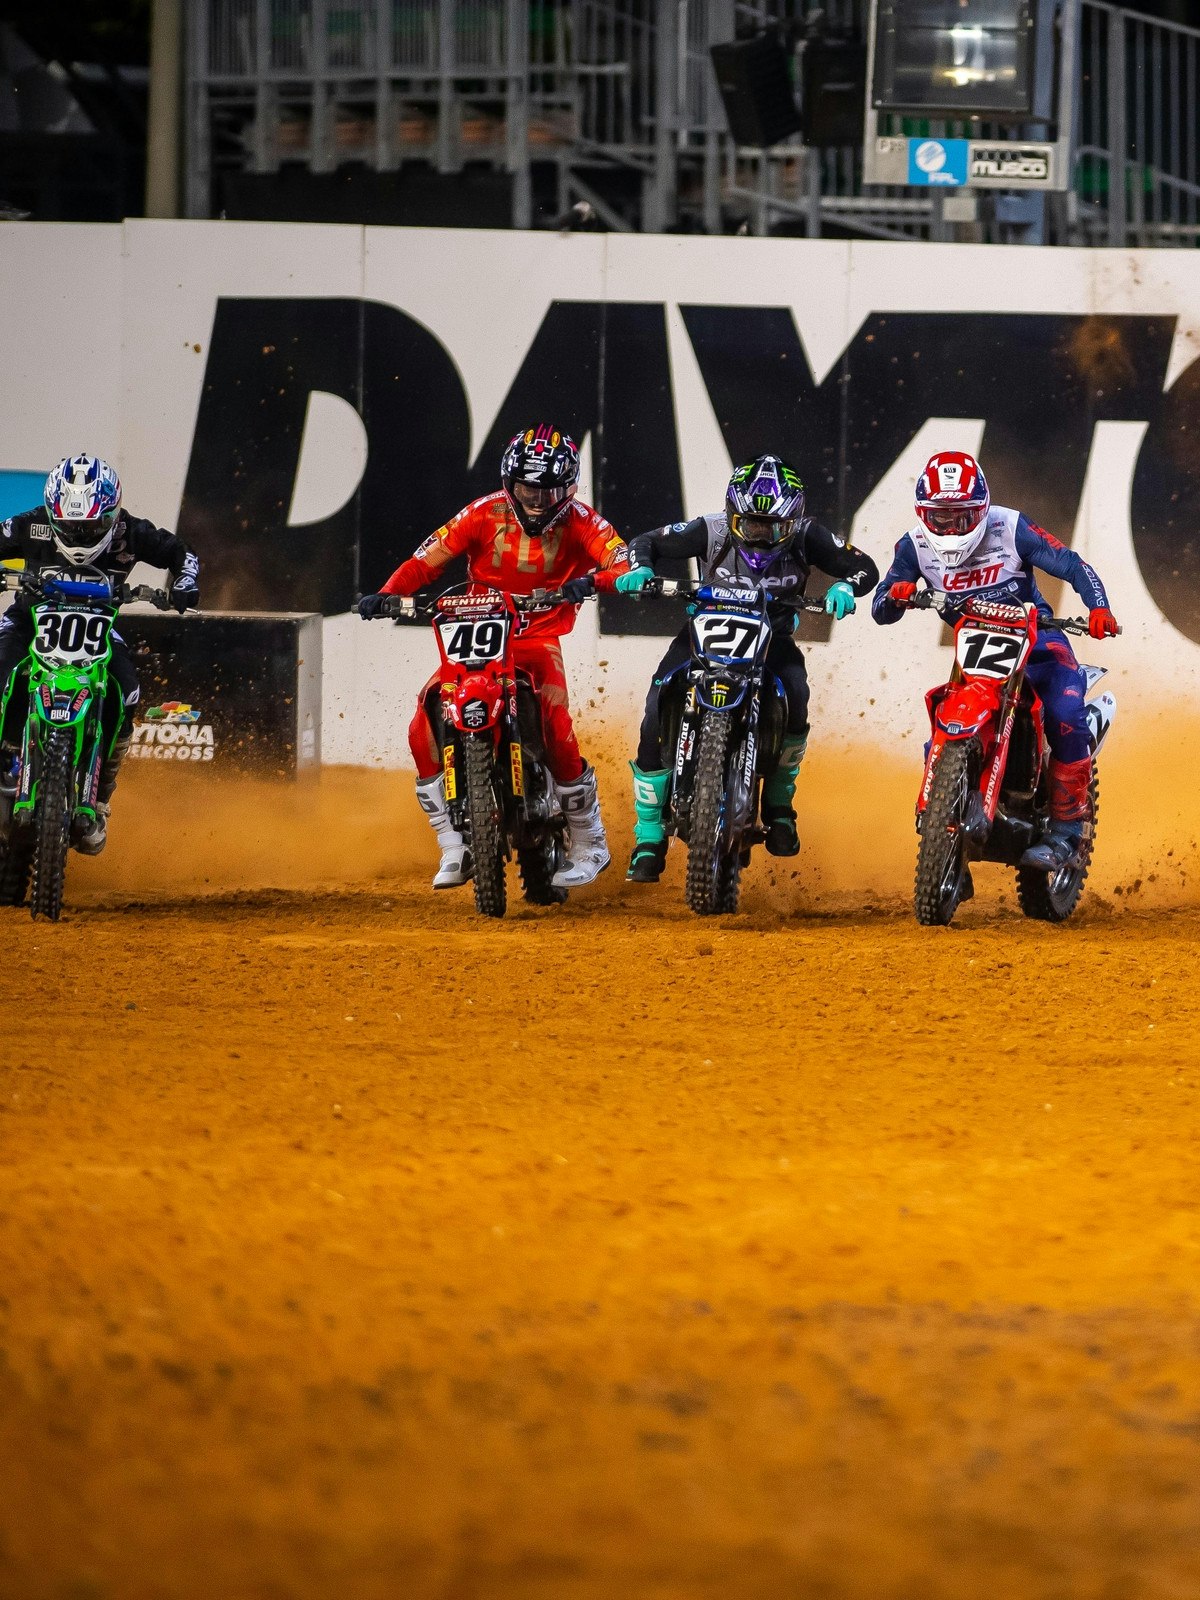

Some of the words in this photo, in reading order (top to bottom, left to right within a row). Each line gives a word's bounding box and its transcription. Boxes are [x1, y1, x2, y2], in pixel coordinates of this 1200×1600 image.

[931, 491, 967, 499] LEATT
[491, 522, 565, 573] FLY
[942, 562, 1005, 591] LEATT
[442, 596, 503, 606] RENTHAL
[35, 613, 112, 656] 309
[447, 621, 504, 660] 49
[703, 618, 760, 658] 27
[963, 632, 1023, 676] 12
[131, 722, 215, 746] YTONA
[444, 747, 456, 798] PIRELLI
[511, 744, 523, 796] PIRELLI
[743, 731, 757, 788] DUNLOP
[984, 755, 1000, 805] DUNLOP
